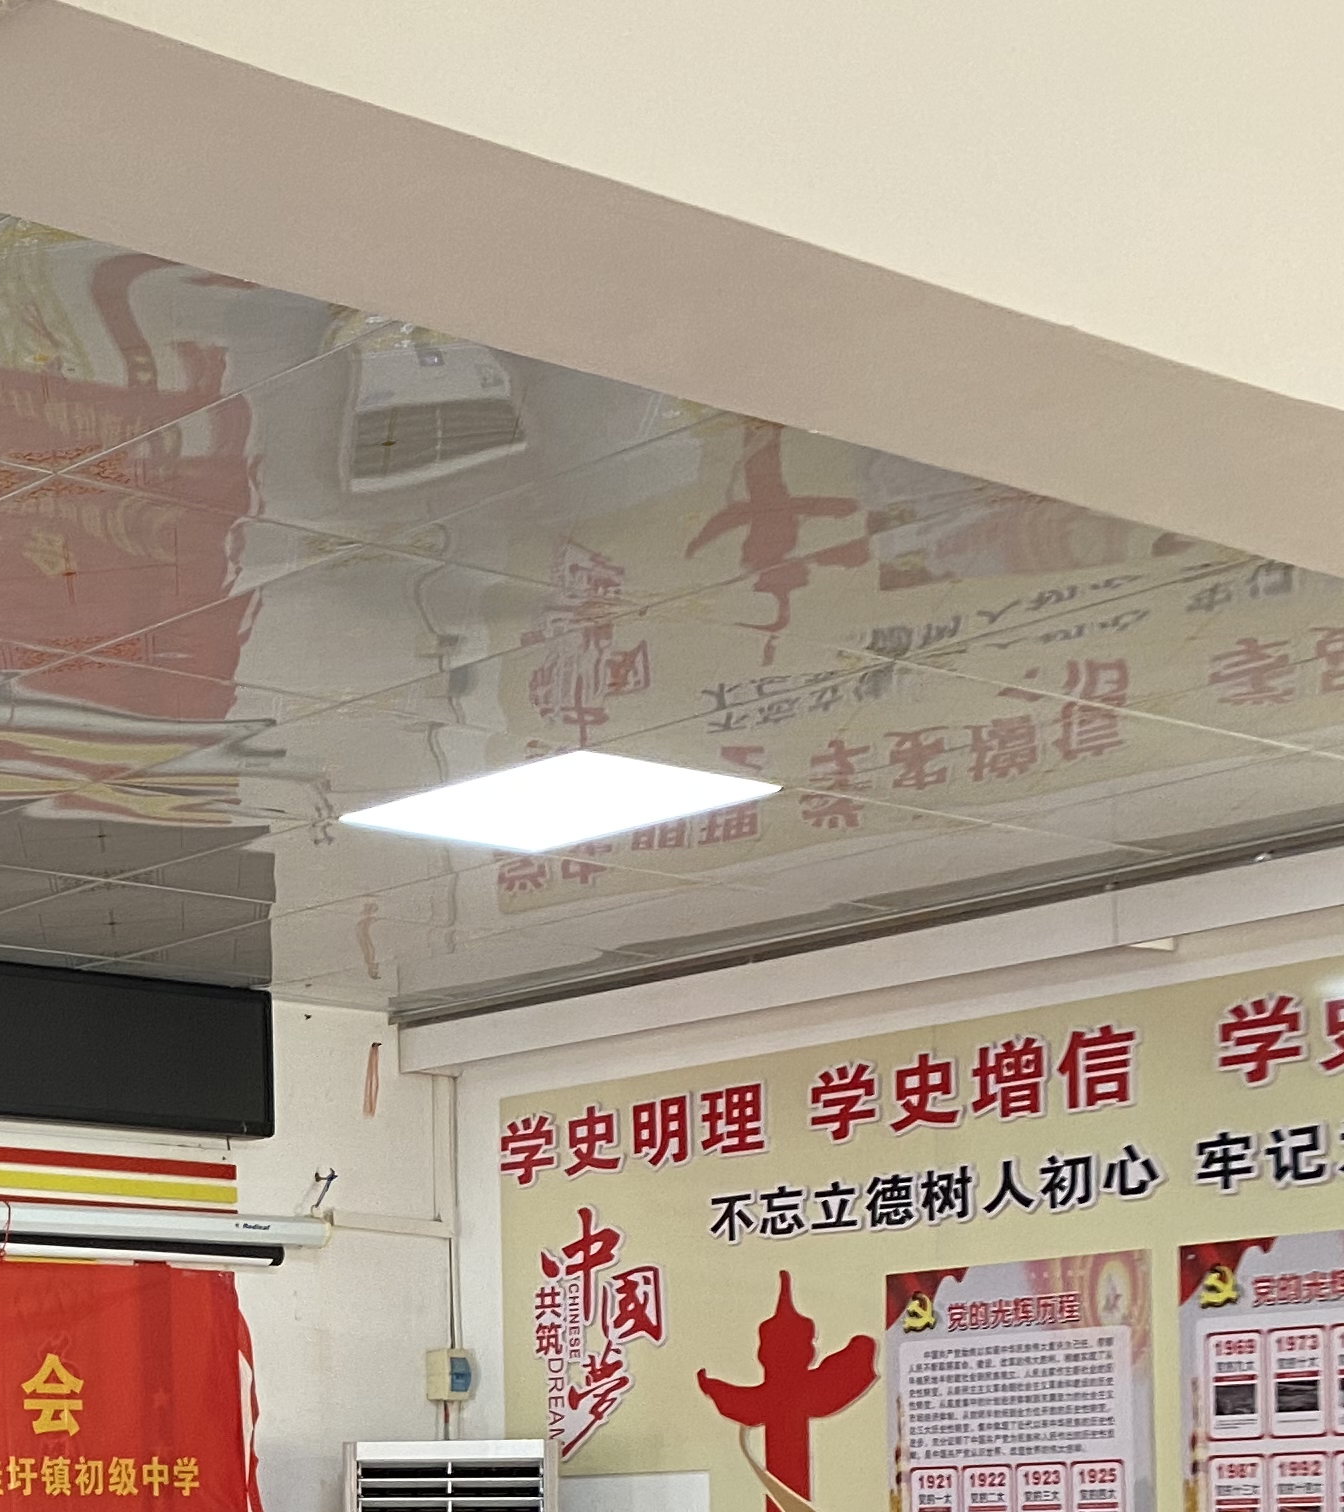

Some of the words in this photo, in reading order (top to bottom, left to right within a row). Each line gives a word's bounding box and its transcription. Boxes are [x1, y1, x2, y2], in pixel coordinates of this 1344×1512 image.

[501, 1083, 765, 1185] 学史明理
[810, 1025, 1137, 1141] 学史增信
[711, 1147, 1158, 1242] 不忘立德树人初心
[1196, 1124, 1344, 1190] 牢记
[535, 1286, 563, 1356] 共筑
[568, 1284, 581, 1359] CHINESE
[947, 1291, 1081, 1332] 党的光辉历程
[918, 1474, 952, 1489] 1921
[970, 1472, 1006, 1487] 1922
[1023, 1470, 1061, 1486] 1923
[1079, 1468, 1117, 1484] 1925
